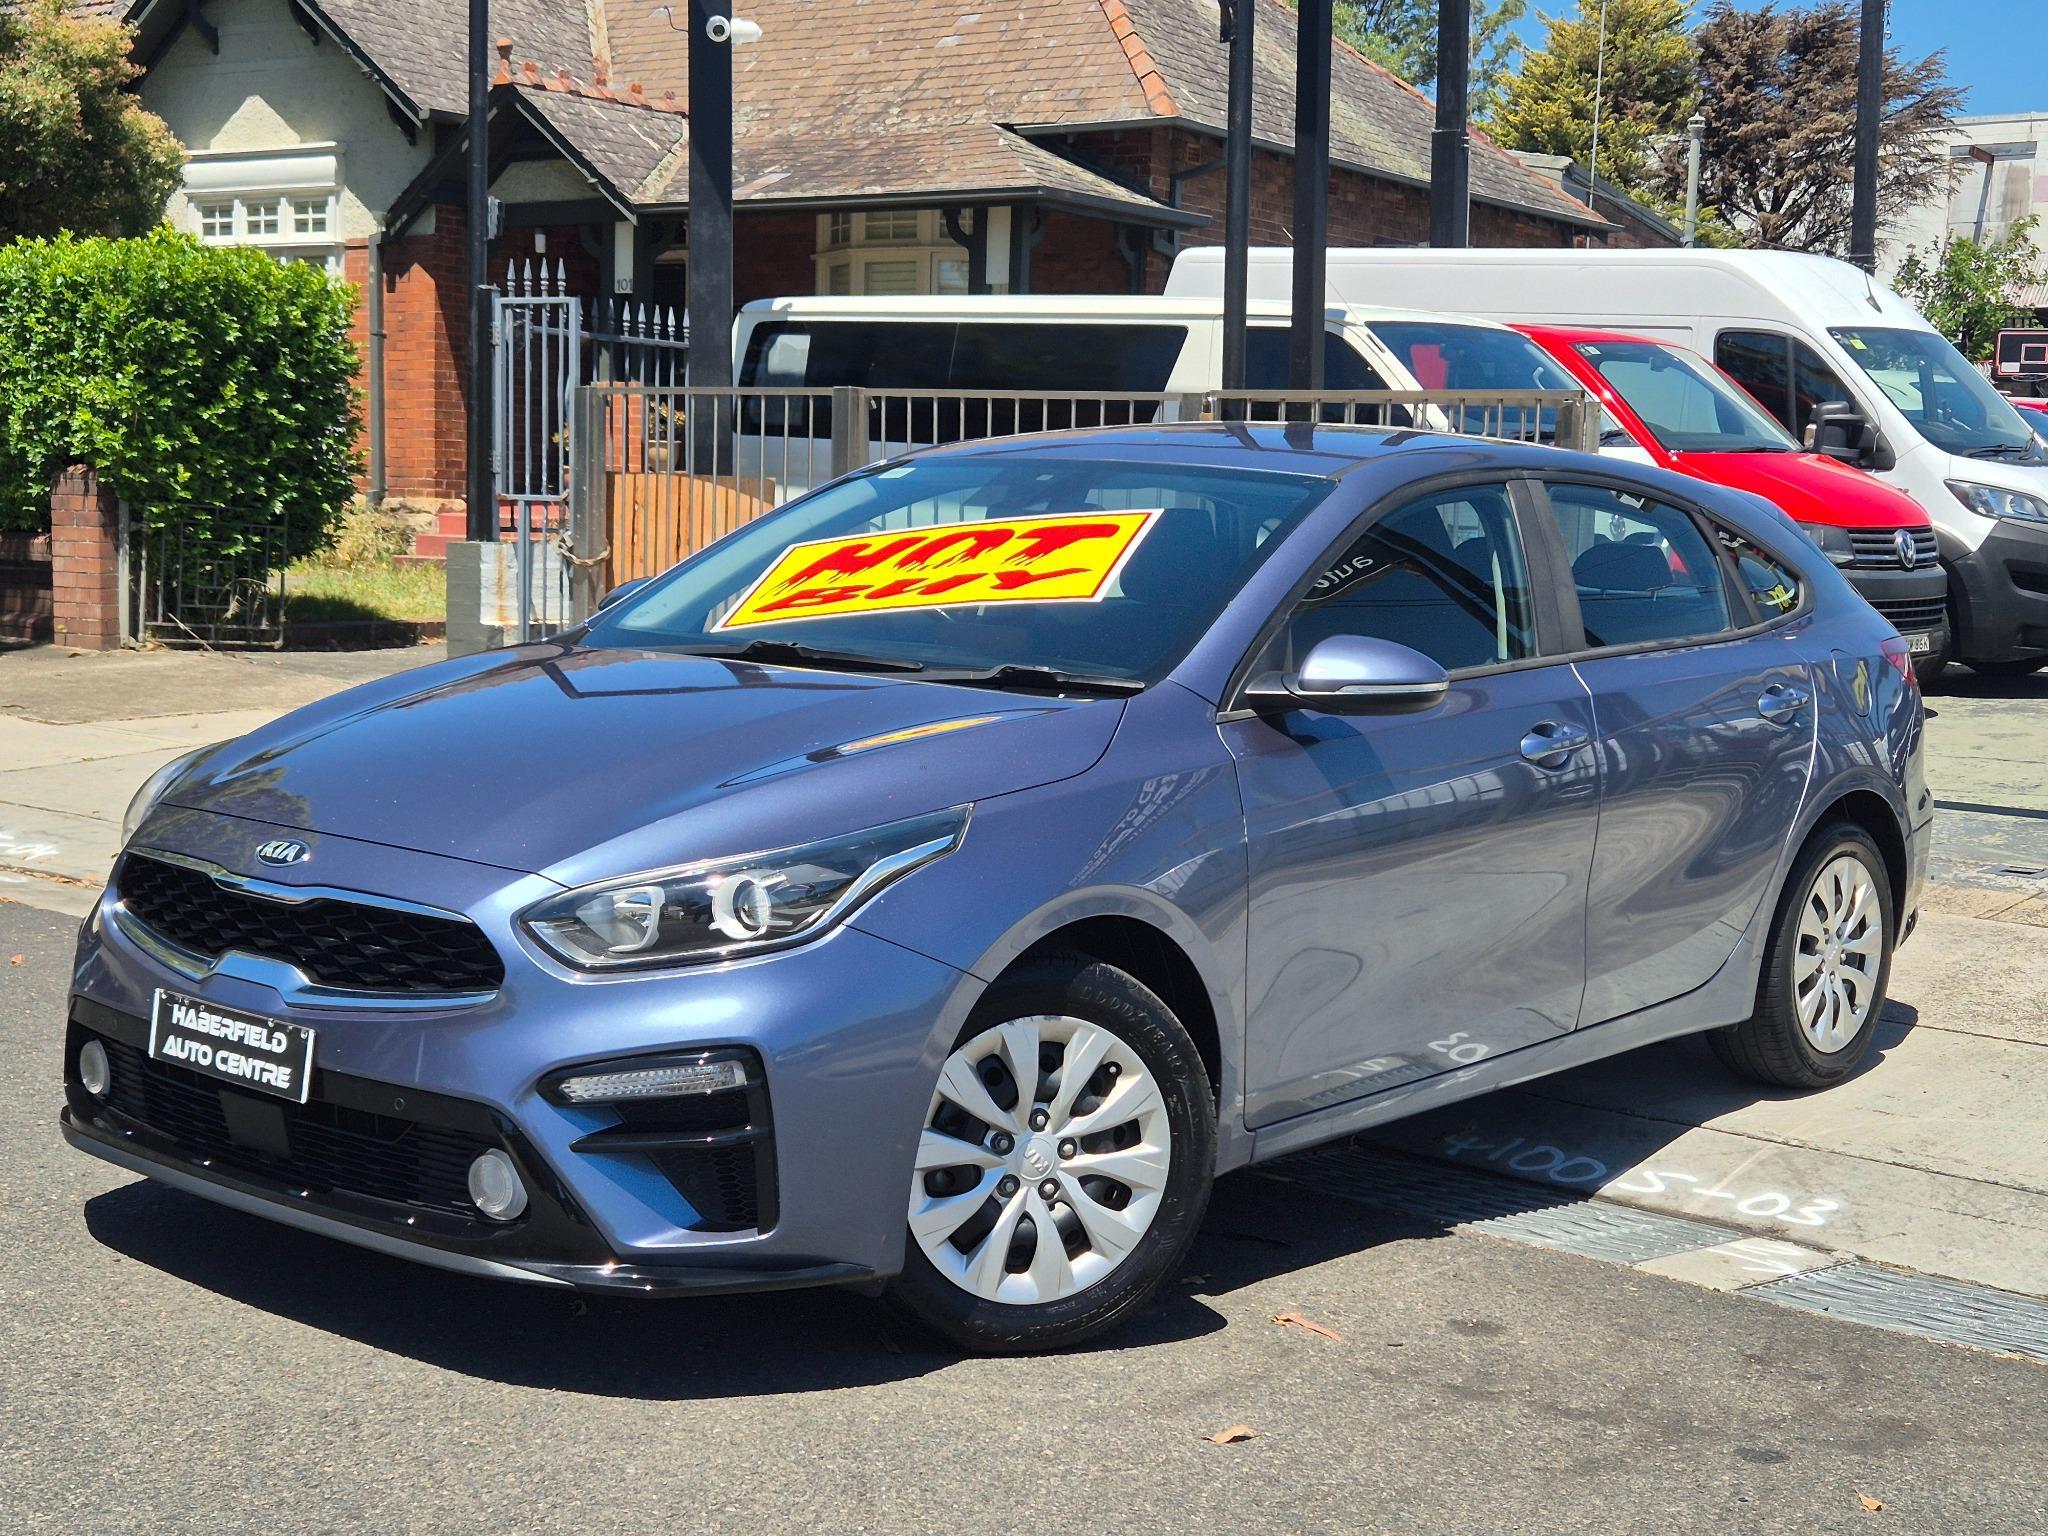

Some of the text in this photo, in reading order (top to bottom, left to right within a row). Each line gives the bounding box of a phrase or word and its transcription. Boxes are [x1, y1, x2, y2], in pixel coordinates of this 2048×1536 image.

[616, 278, 633, 291] 101
[759, 523, 1121, 600] HOT
[752, 567, 1092, 613] BUY
[260, 841, 301, 862] KIA
[172, 1004, 288, 1054] HABERFIELD
[162, 1035, 293, 1090] AUTO CENTRE
